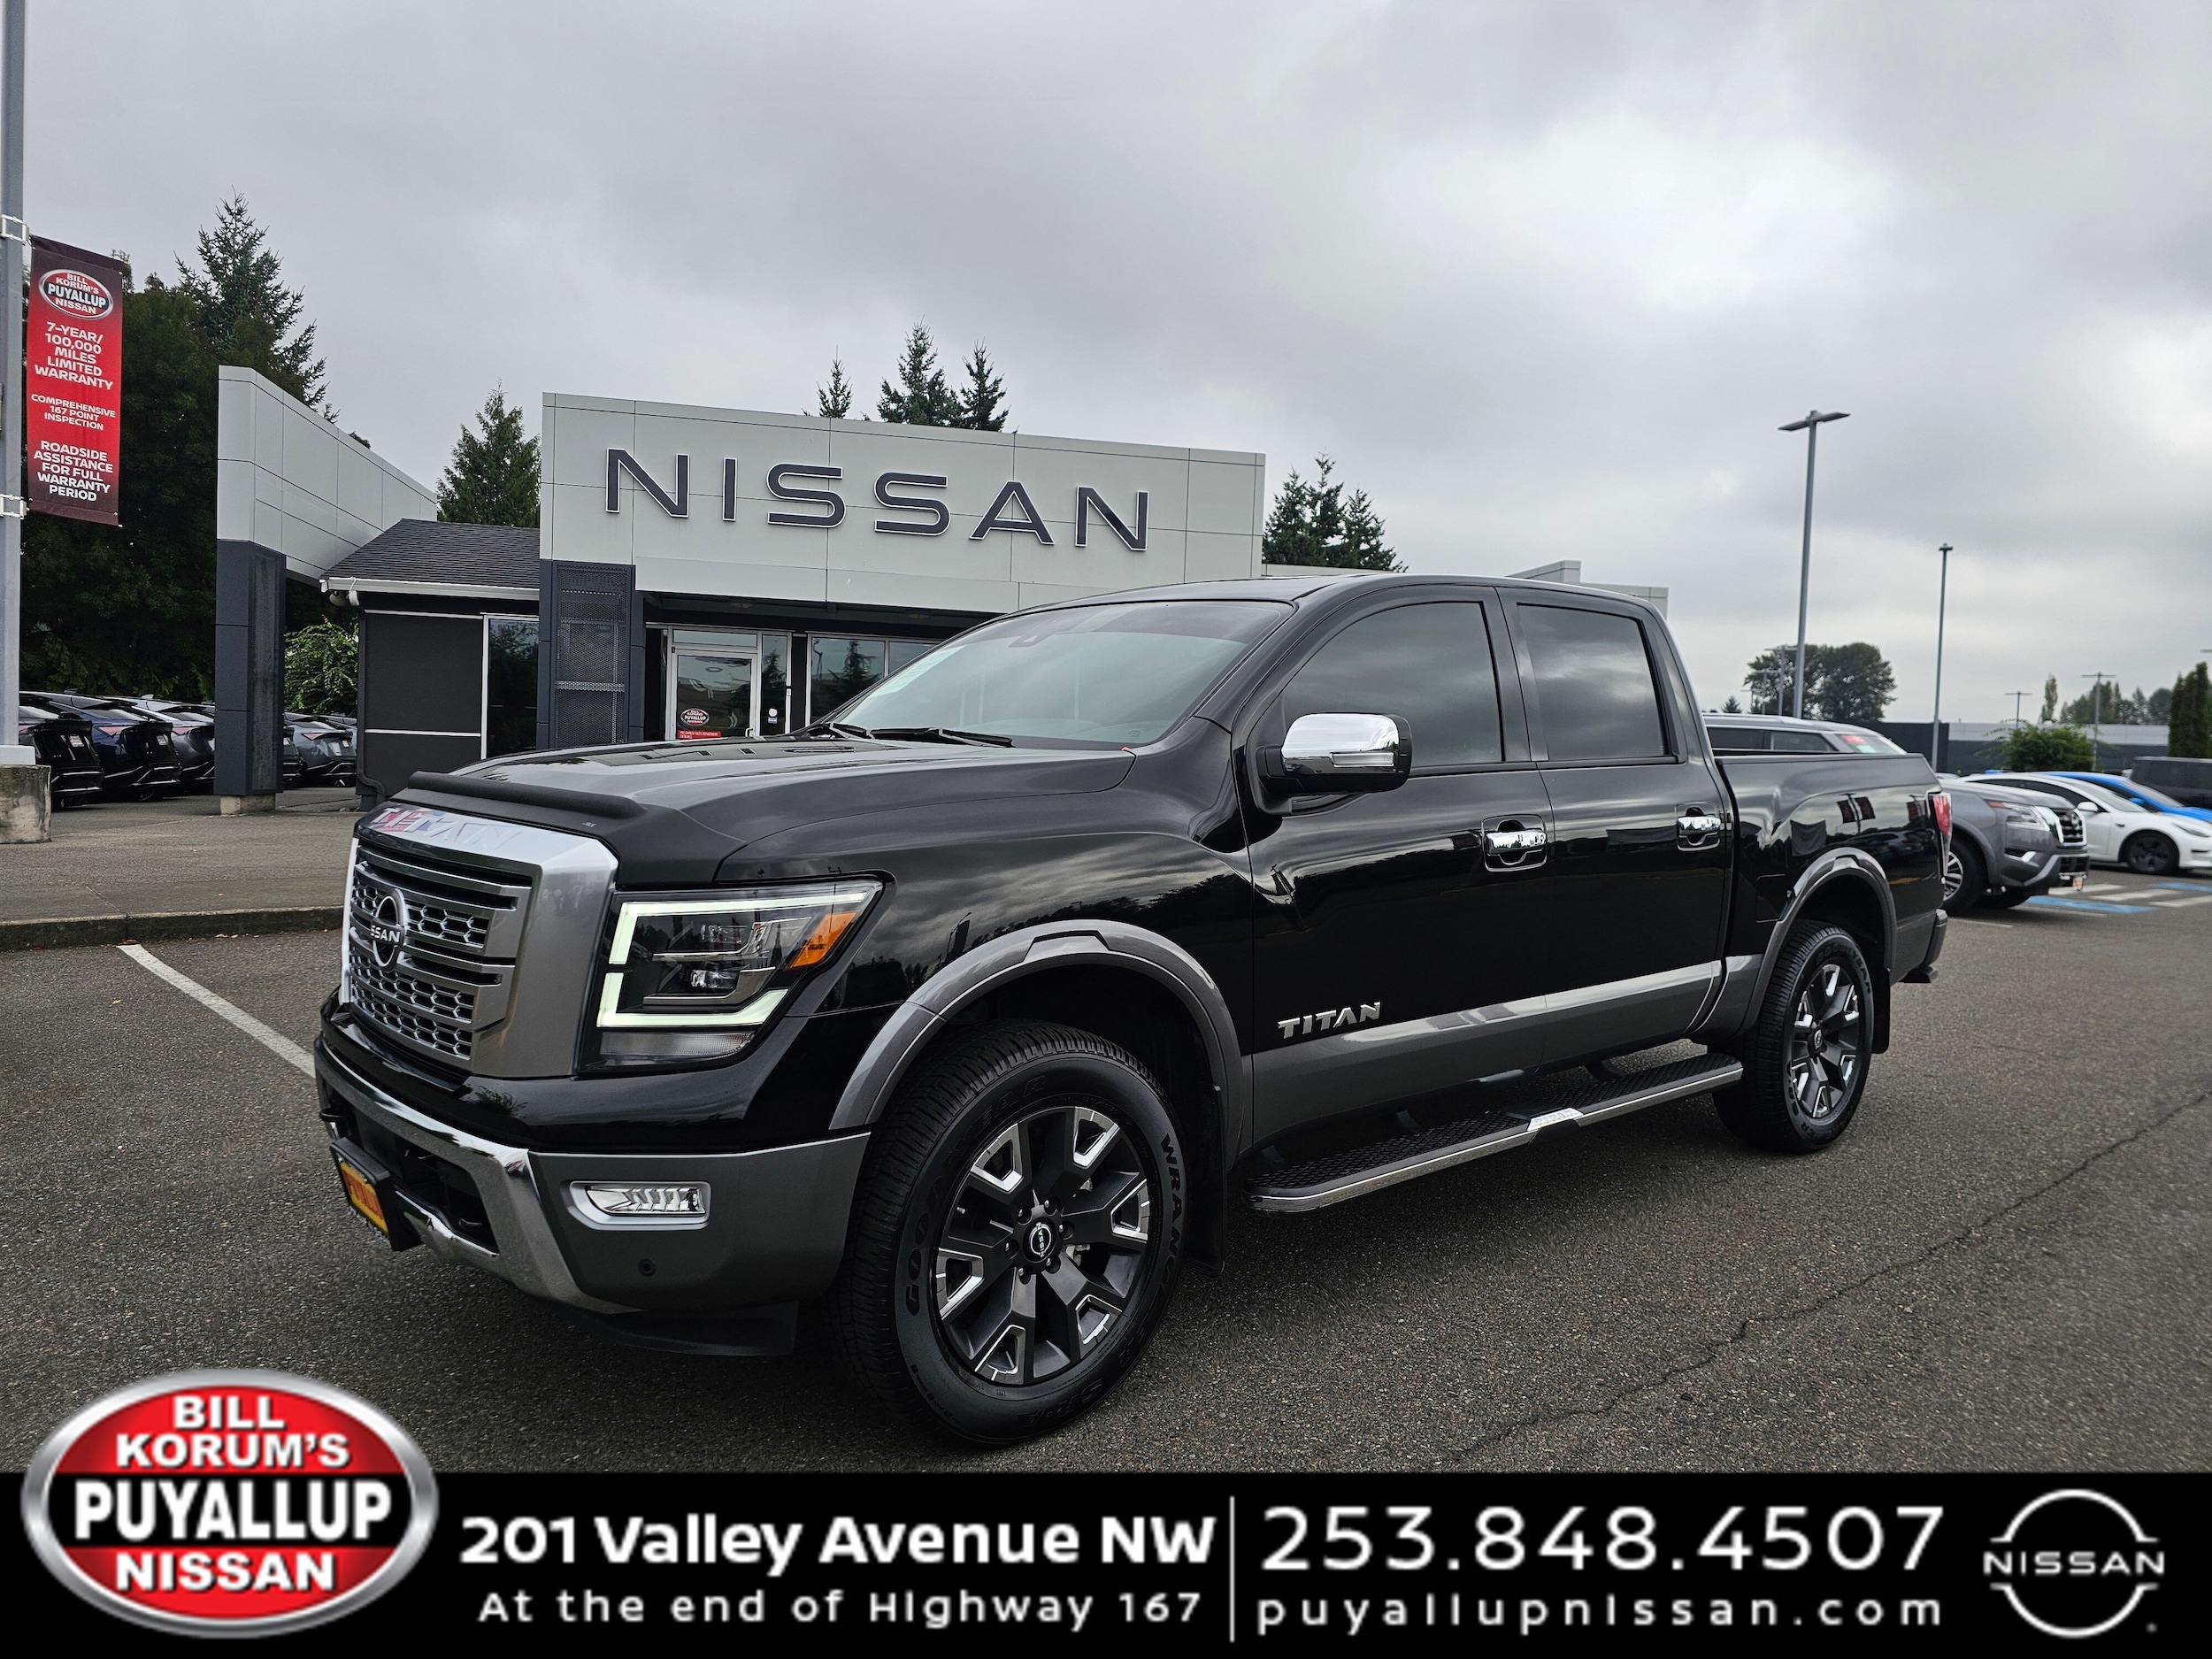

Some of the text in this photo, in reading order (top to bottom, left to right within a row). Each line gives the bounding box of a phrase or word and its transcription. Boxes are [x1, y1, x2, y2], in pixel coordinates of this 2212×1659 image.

[56, 277, 99, 295] KORUM'S
[66, 273, 88, 285] BILL
[48, 283, 107, 309] PUYALLUP
[55, 297, 96, 315] NISSAN
[46, 321, 104, 344] 7-YEAR/
[45, 333, 102, 355] 100,000
[47, 356, 103, 377] LIMITED
[55, 346, 96, 365] MILES
[35, 364, 113, 390] WARRANTY
[31, 394, 116, 419] COMPREHENSIVE
[50, 405, 99, 422] 167 POINT
[44, 411, 104, 431] INSPECTION
[34, 449, 113, 473] ASSISTANCE
[41, 440, 108, 462] ROADSIDE
[37, 472, 111, 494] WARRANTY
[42, 462, 104, 482] FOR FULL
[49, 484, 97, 502] PERIOD
[605, 448, 1149, 551] NISSAN
[371, 806, 523, 850] TITAN
[1278, 1002, 1380, 1040] TITAN
